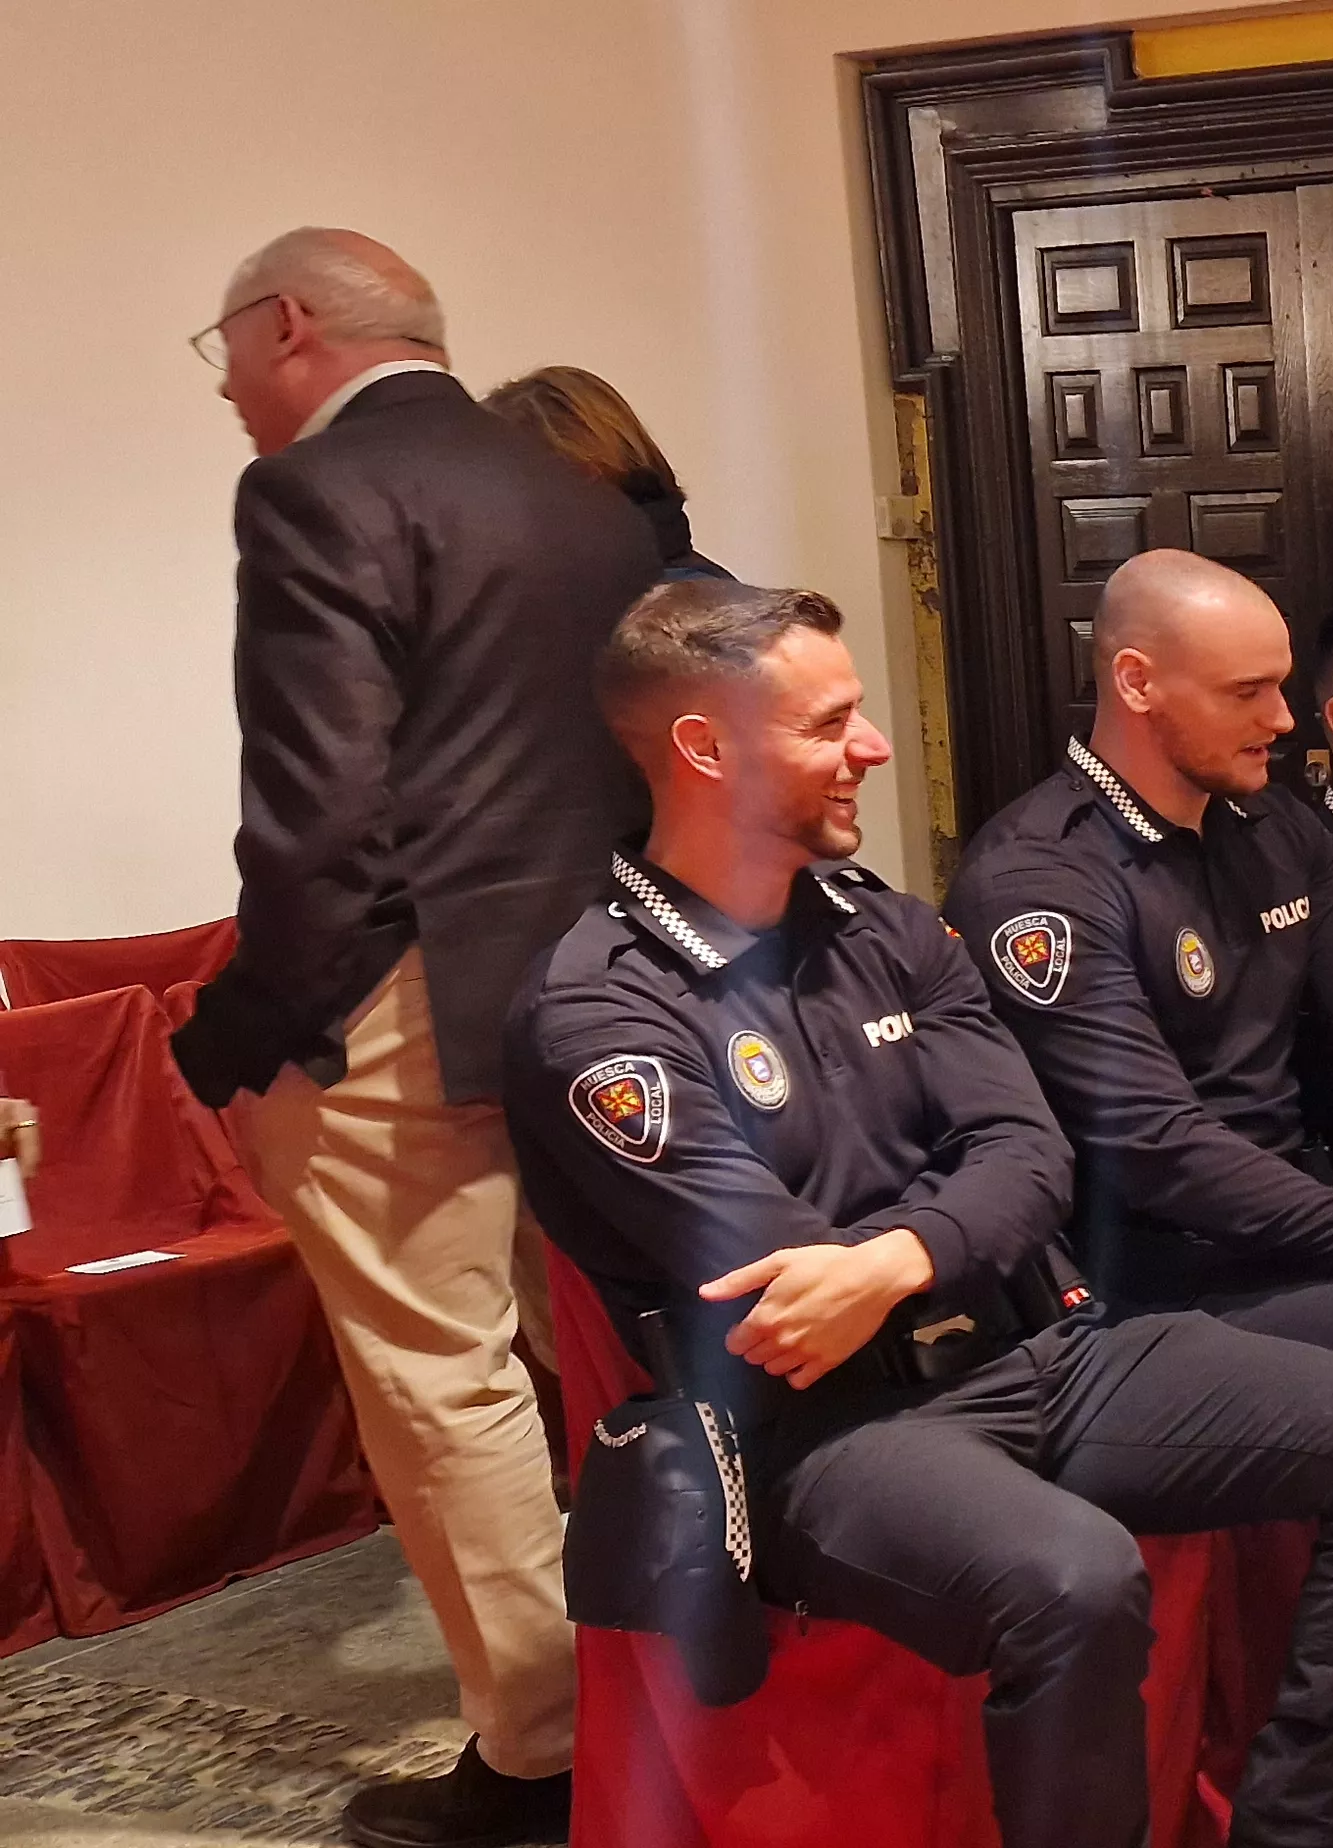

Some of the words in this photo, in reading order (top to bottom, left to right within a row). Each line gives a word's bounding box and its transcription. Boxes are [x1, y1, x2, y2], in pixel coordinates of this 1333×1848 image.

[1004, 917, 1049, 937] HUESCA
[1053, 937, 1066, 973] LOCAL
[1000, 956, 1031, 990] POLICIA
[579, 1061, 637, 1091] HUESCA
[650, 1081, 663, 1125] LOCAL
[586, 1111, 627, 1149] POLICIA
